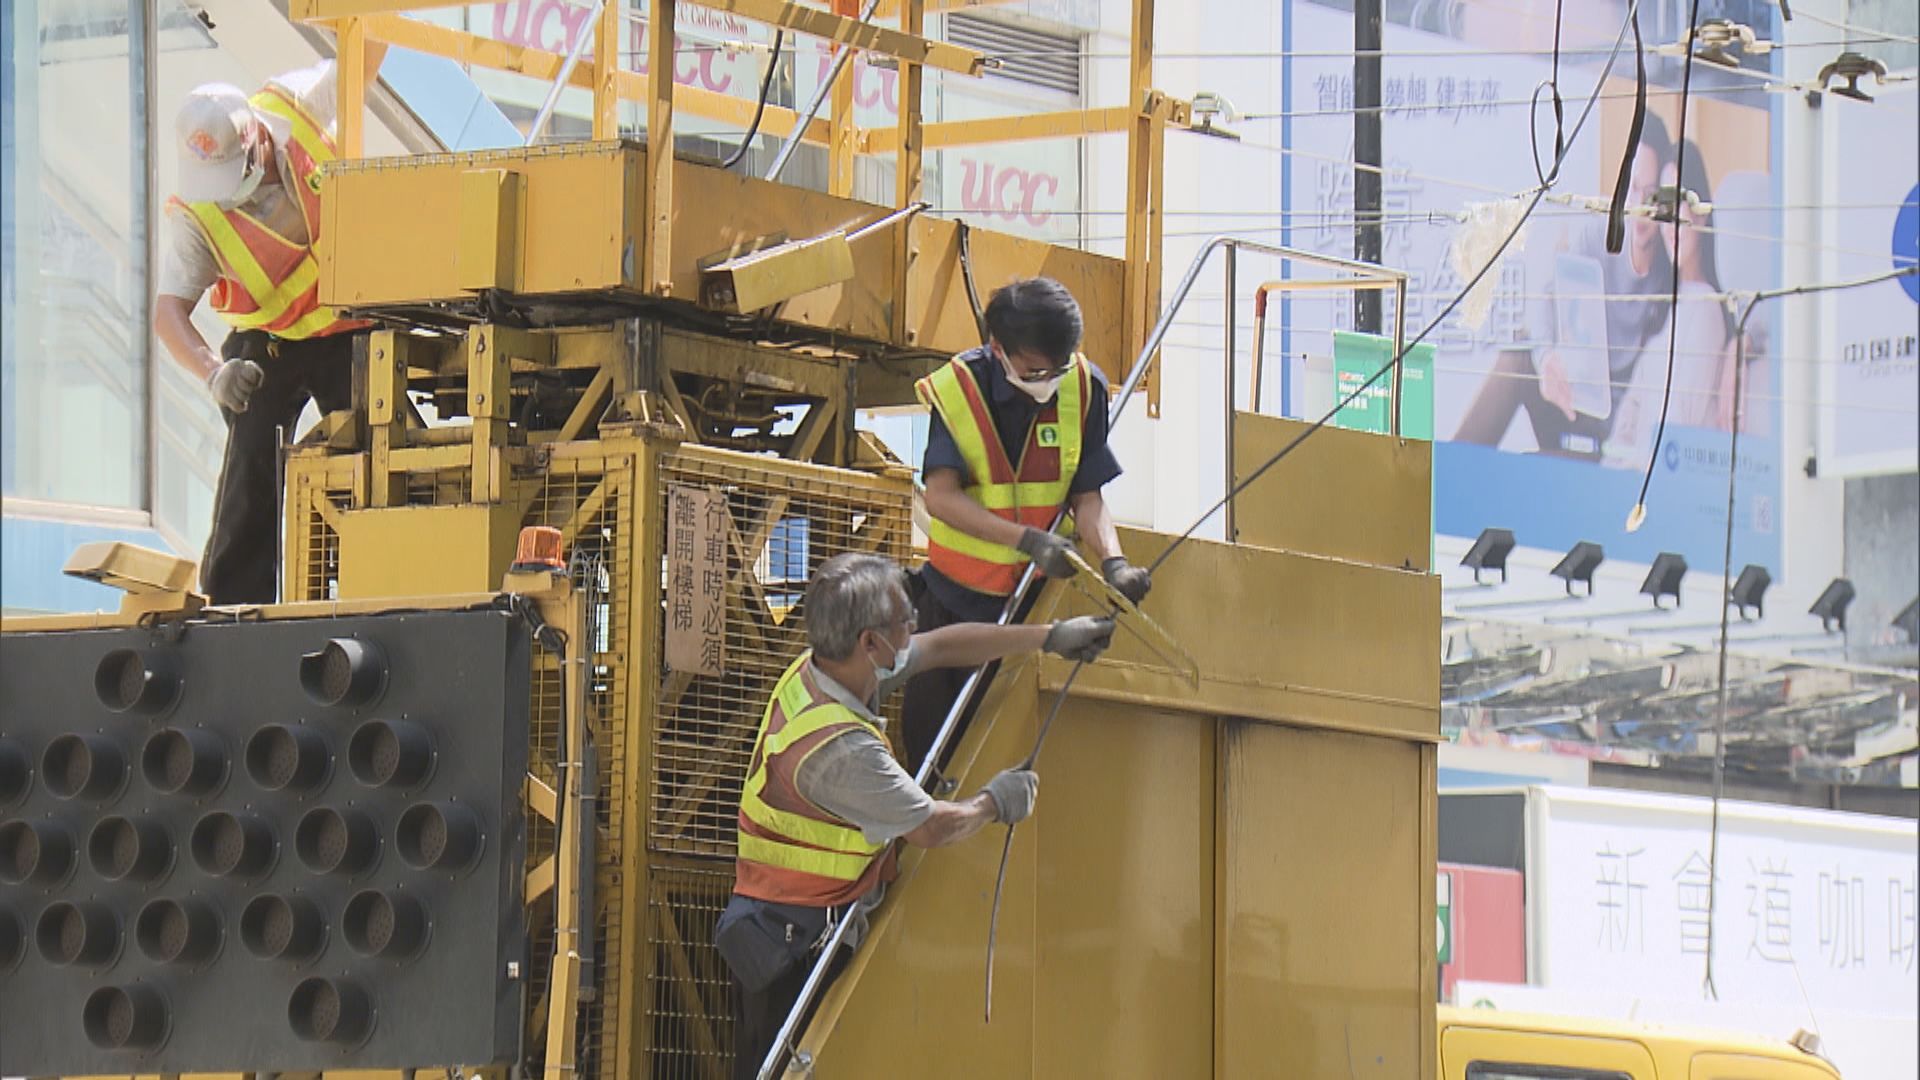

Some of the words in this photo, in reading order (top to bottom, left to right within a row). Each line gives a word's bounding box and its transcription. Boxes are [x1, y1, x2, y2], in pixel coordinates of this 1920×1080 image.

[691, 5, 722, 31] Coffee
[723, 14, 748, 36] Shop
[672, 493, 696, 633] 離開樓梯
[701, 497, 727, 672] 行車時必須
